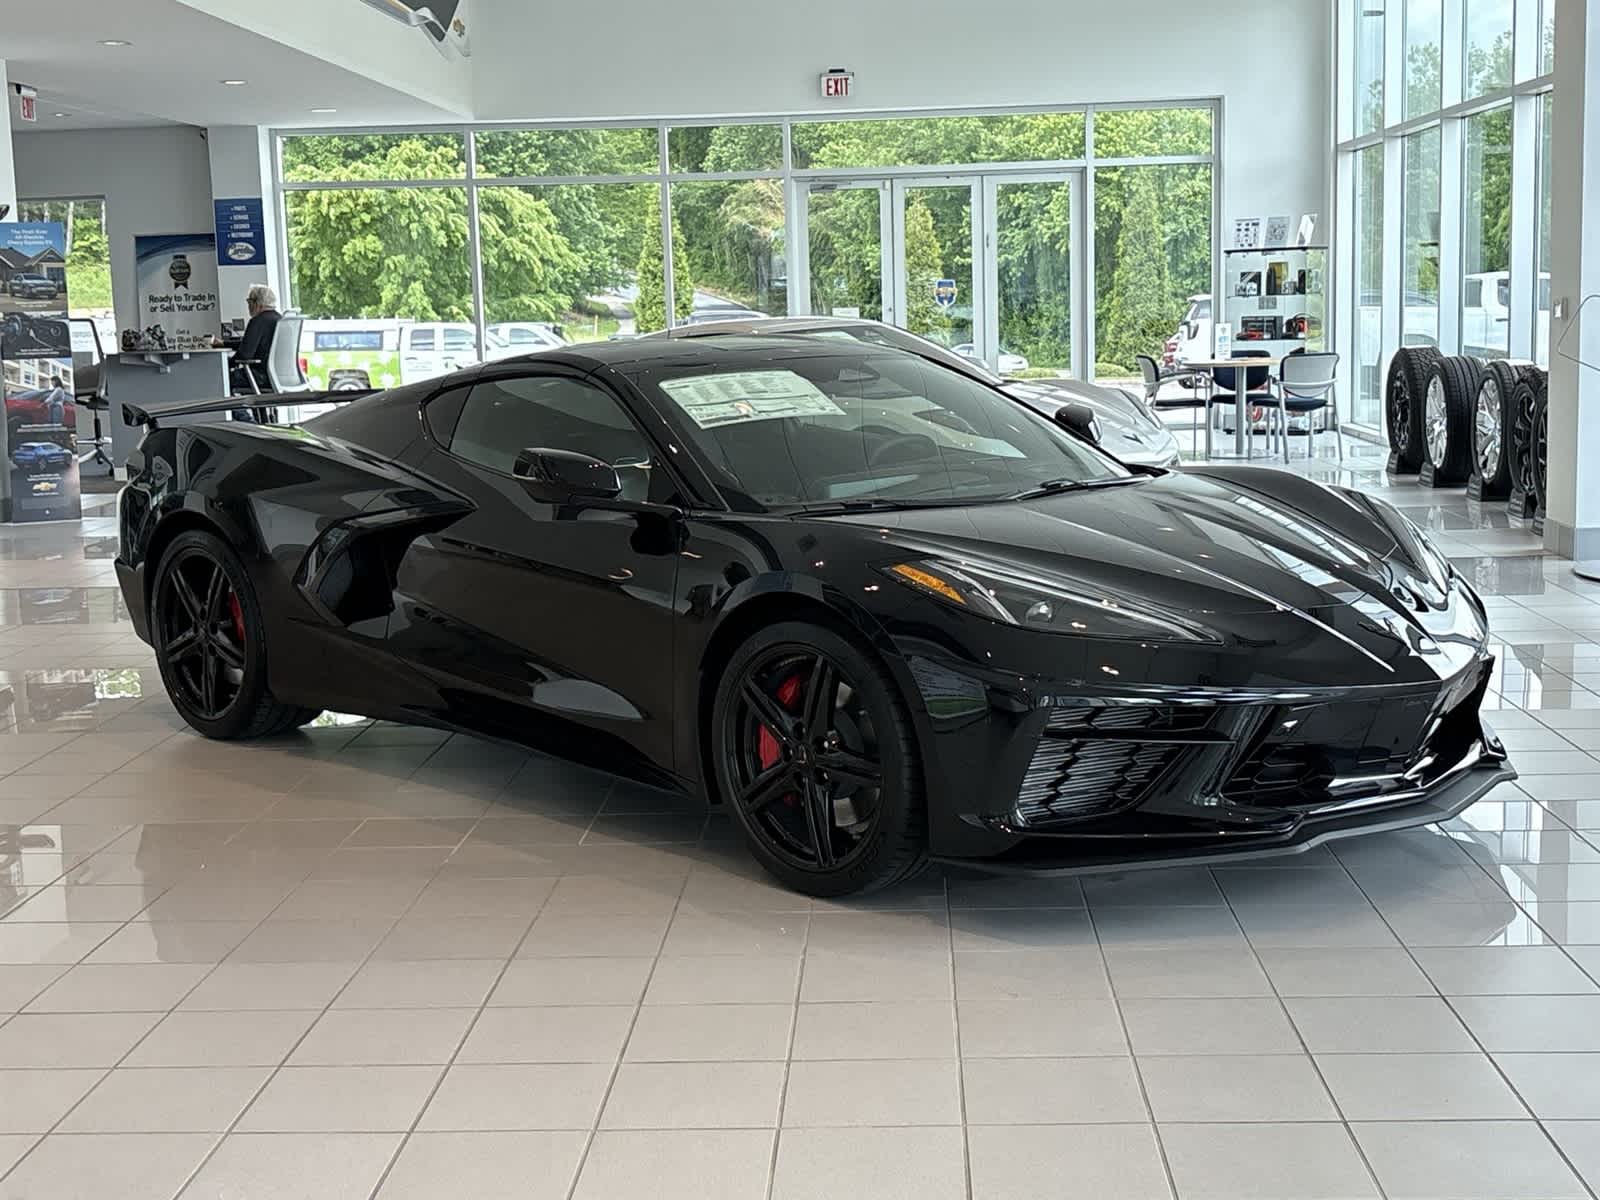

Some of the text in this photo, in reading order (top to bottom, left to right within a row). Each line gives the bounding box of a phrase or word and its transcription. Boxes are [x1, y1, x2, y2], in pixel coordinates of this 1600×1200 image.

[826, 77, 849, 97] EXIT
[148, 292, 216, 304] Ready to Trade In
[159, 303, 175, 313] Sell
[176, 303, 194, 312] Your
[196, 302, 216, 312] Car?
